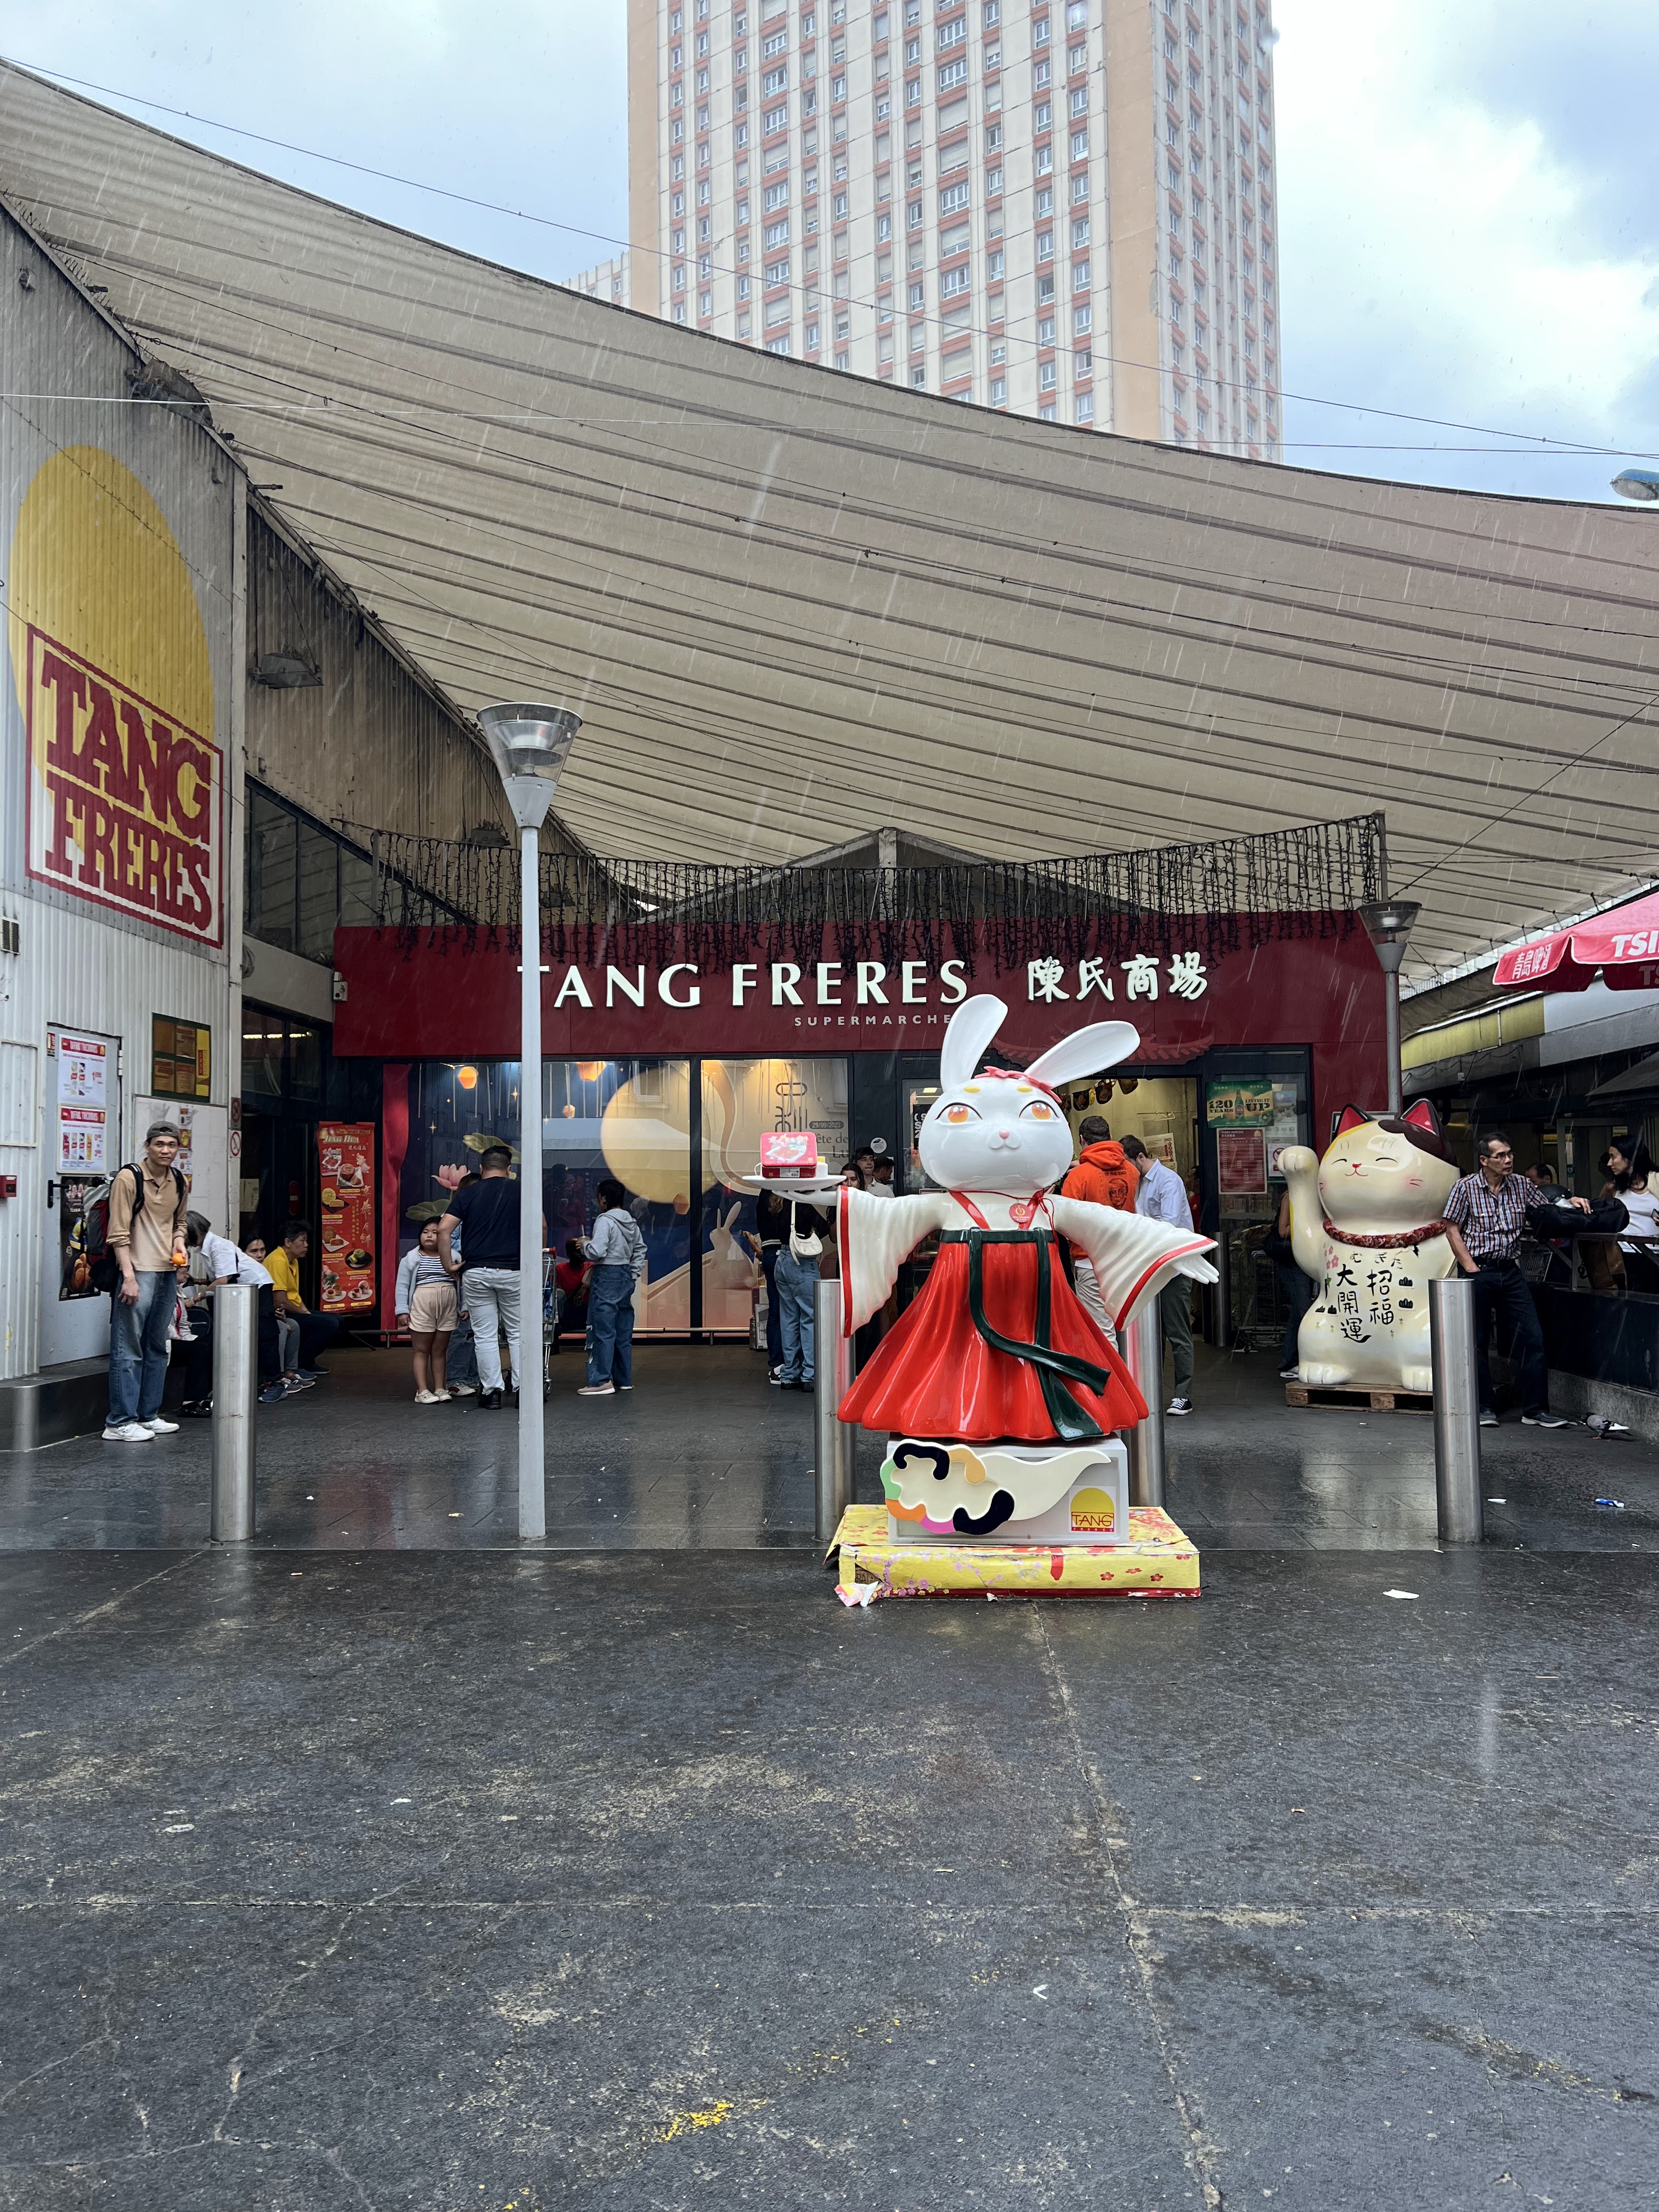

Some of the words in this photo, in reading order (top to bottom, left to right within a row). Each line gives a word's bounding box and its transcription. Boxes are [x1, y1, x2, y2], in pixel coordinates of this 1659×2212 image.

[41, 648, 211, 845] TANG
[45, 771, 212, 932] FRERES
[1611, 930, 1659, 957] TSI
[732, 960, 967, 1007] FRERES
[1028, 951, 1207, 1003] 陳氏商場
[1639, 965, 1659, 985] T
[794, 1014, 951, 1026] SUPERMARCHE
[1209, 1099, 1233, 1109] 120
[1246, 1103, 1271, 1111] UP
[343, 1135, 359, 1143] HUA
[816, 1133, 832, 1143] ête
[832, 1146, 849, 1158] Lu
[1336, 1263, 1372, 1343] 大開運
[1366, 1269, 1395, 1325] 招福
[1071, 1515, 1114, 1527] TANG
